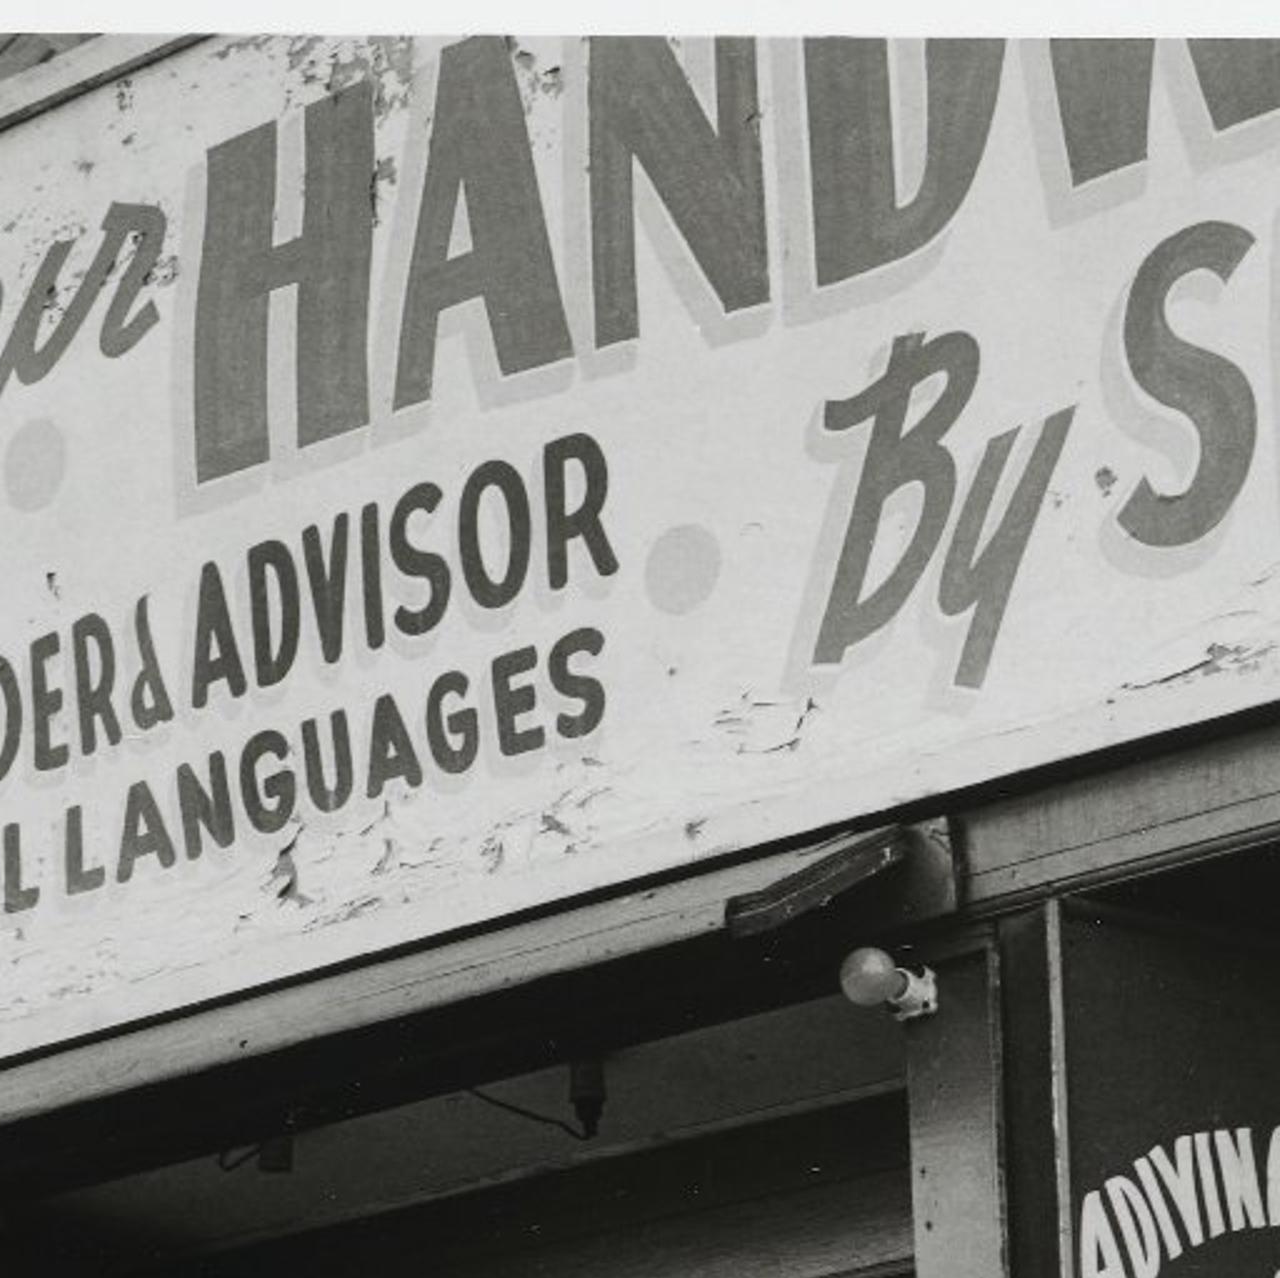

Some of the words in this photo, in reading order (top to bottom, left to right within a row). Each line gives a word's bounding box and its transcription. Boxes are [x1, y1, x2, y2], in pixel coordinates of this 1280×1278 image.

[191, 431, 619, 710] ADVISOR
[810, 329, 1078, 690] By
[64, 626, 607, 896] LANGUAGES
